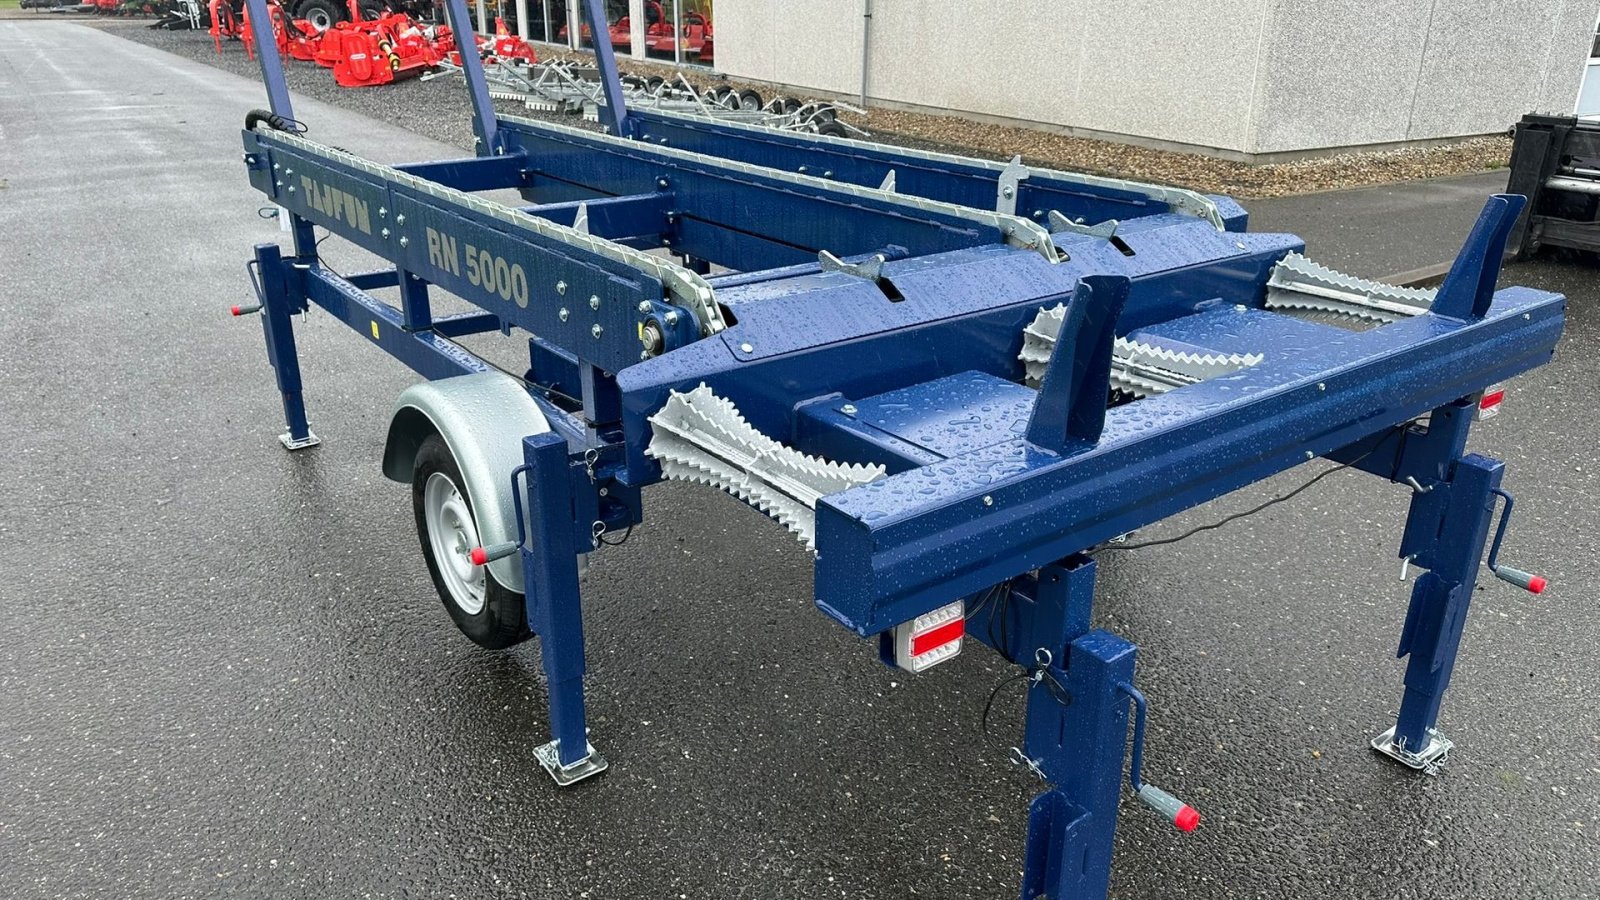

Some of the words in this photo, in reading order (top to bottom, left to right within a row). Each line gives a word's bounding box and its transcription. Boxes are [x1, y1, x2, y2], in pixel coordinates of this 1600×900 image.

[300, 174, 372, 236] TAJFUN
[426, 226, 460, 277] RN
[465, 243, 529, 309] 5000
